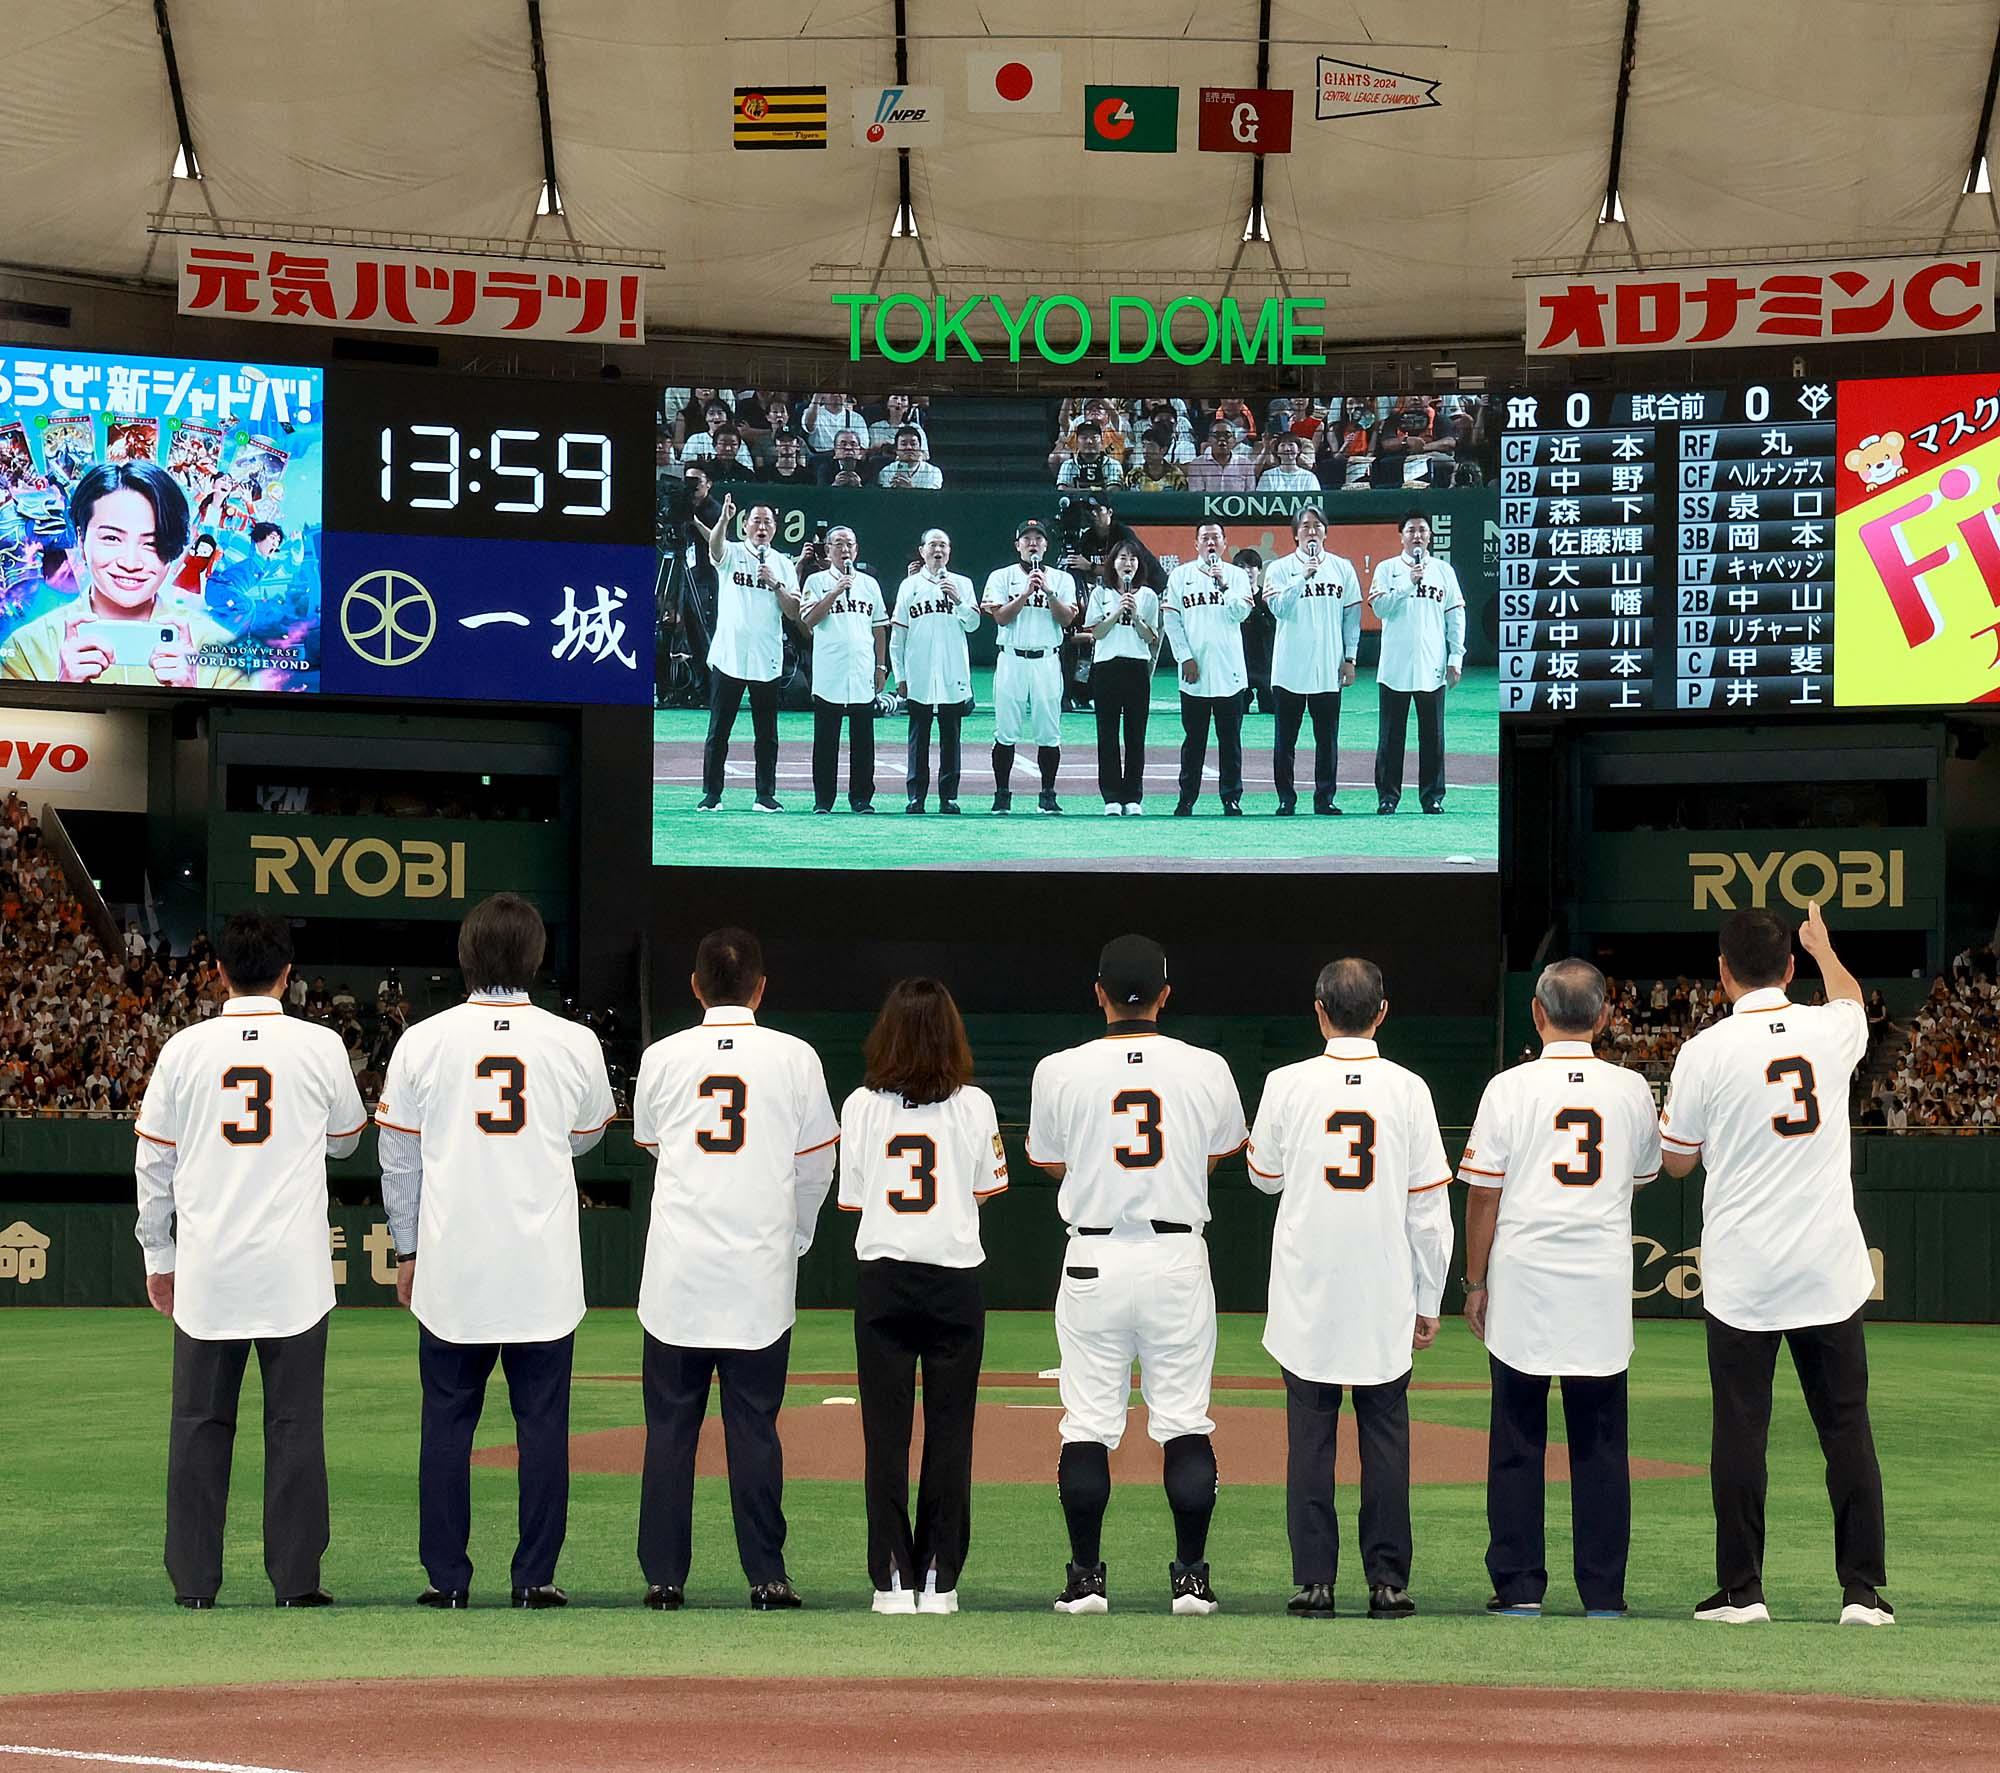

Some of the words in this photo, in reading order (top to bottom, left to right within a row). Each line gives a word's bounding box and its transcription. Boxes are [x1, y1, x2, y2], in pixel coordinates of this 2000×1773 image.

[1324, 72, 1371, 88] GIANTS
[1373, 78, 1397, 89] 2024
[1323, 91, 1351, 102] CENTRAL
[1353, 93, 1380, 103] LEAGUE
[1381, 93, 1421, 105] CHAMPIONS
[889, 110, 926, 121] NPB
[1230, 103, 1259, 143] G
[186, 247, 640, 338] 元気ハツラツ!
[1538, 261, 1983, 349] オロナミンC
[832, 294, 1093, 364] TOKYO
[1109, 295, 1326, 366] DOME
[1566, 392, 1590, 428] 0
[1631, 393, 1705, 422] 試合前
[1745, 386, 1770, 422] 0
[1506, 440, 1532, 462] CF
[1547, 433, 1643, 462] 近本
[1684, 435, 1711, 456] RF
[1761, 427, 1792, 455] 丸
[380, 425, 613, 516] 13:59
[1506, 471, 1530, 492] 2B
[1550, 466, 1643, 493] 中野
[1684, 466, 1710, 487] CF
[1729, 458, 1823, 486] ヘルナンデス
[1506, 502, 1530, 523] RF
[1549, 497, 1643, 524] 森下
[1683, 497, 1709, 518] SS
[1729, 492, 1821, 519] 泉口
[1505, 532, 1530, 554] 3B
[1549, 528, 1642, 555] 佐藤輝
[1683, 528, 1709, 549] 3B
[1729, 521, 1823, 550] 岡本
[1507, 563, 1530, 585] 1B
[1549, 558, 1641, 586] 大山
[1684, 559, 1708, 580] LF
[1728, 552, 1823, 580] キャベッジ
[1505, 594, 1530, 616] SS
[1549, 589, 1642, 617] 小幡
[1682, 590, 1709, 611] 2B
[1729, 584, 1821, 612] 中山
[1506, 625, 1528, 647] LF
[1550, 620, 1640, 648] 中川
[1684, 621, 1708, 642] 1B
[1730, 616, 1821, 642] リチャード
[187, 655, 246, 667] WORLDS
[252, 658, 310, 670] BEYOND
[201, 644, 299, 657] SHADOWVERSE
[1510, 656, 1523, 678] C
[1548, 651, 1641, 678] 坂本
[1688, 652, 1701, 673] C
[1729, 646, 1822, 674] 甲斐
[1511, 687, 1523, 709] P
[1548, 682, 1641, 709] 村上
[1688, 683, 1701, 704] P
[1727, 678, 1822, 705] 井上
[249, 835, 466, 899] RYOBI
[1688, 849, 1904, 911] RYOBI
[221, 1065, 274, 1147] 3
[474, 1055, 527, 1136] 3
[1765, 1055, 1823, 1139] 3
[695, 1074, 748, 1155] 3
[1111, 1088, 1164, 1170] 3
[1323, 1110, 1376, 1192] 3
[1552, 1106, 1602, 1188] 3
[885, 1133, 938, 1215] 3
